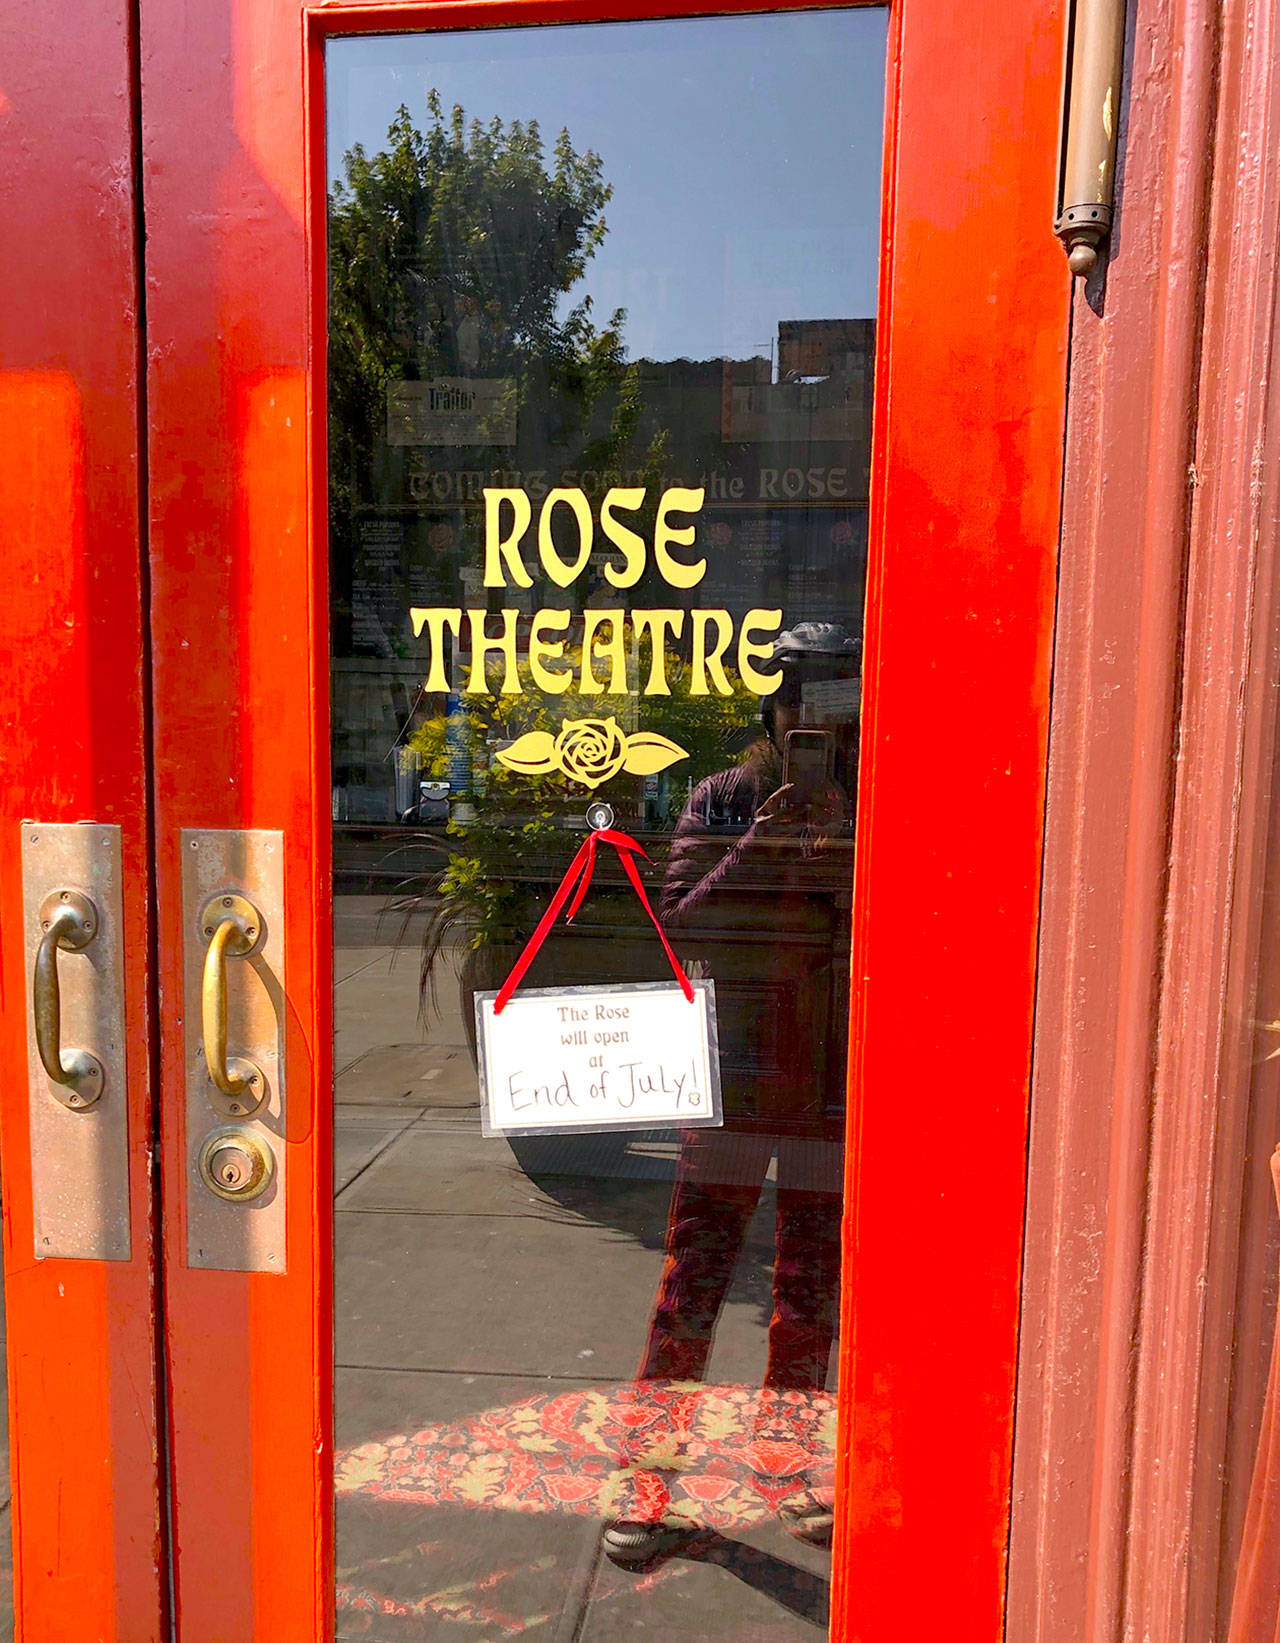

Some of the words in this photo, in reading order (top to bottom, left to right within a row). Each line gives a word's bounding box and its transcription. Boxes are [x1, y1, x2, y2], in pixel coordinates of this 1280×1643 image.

[760, 467, 848, 498] ROSE
[483, 488, 706, 588] ROSE
[410, 609, 784, 695] THEATRE
[557, 1006, 590, 1023] The
[595, 1004, 630, 1020] Rose
[560, 1031, 588, 1046] will
[593, 1030, 630, 1046] open
[588, 1053, 604, 1068] at
[508, 1070, 580, 1112] End
[589, 1070, 610, 1100] of
